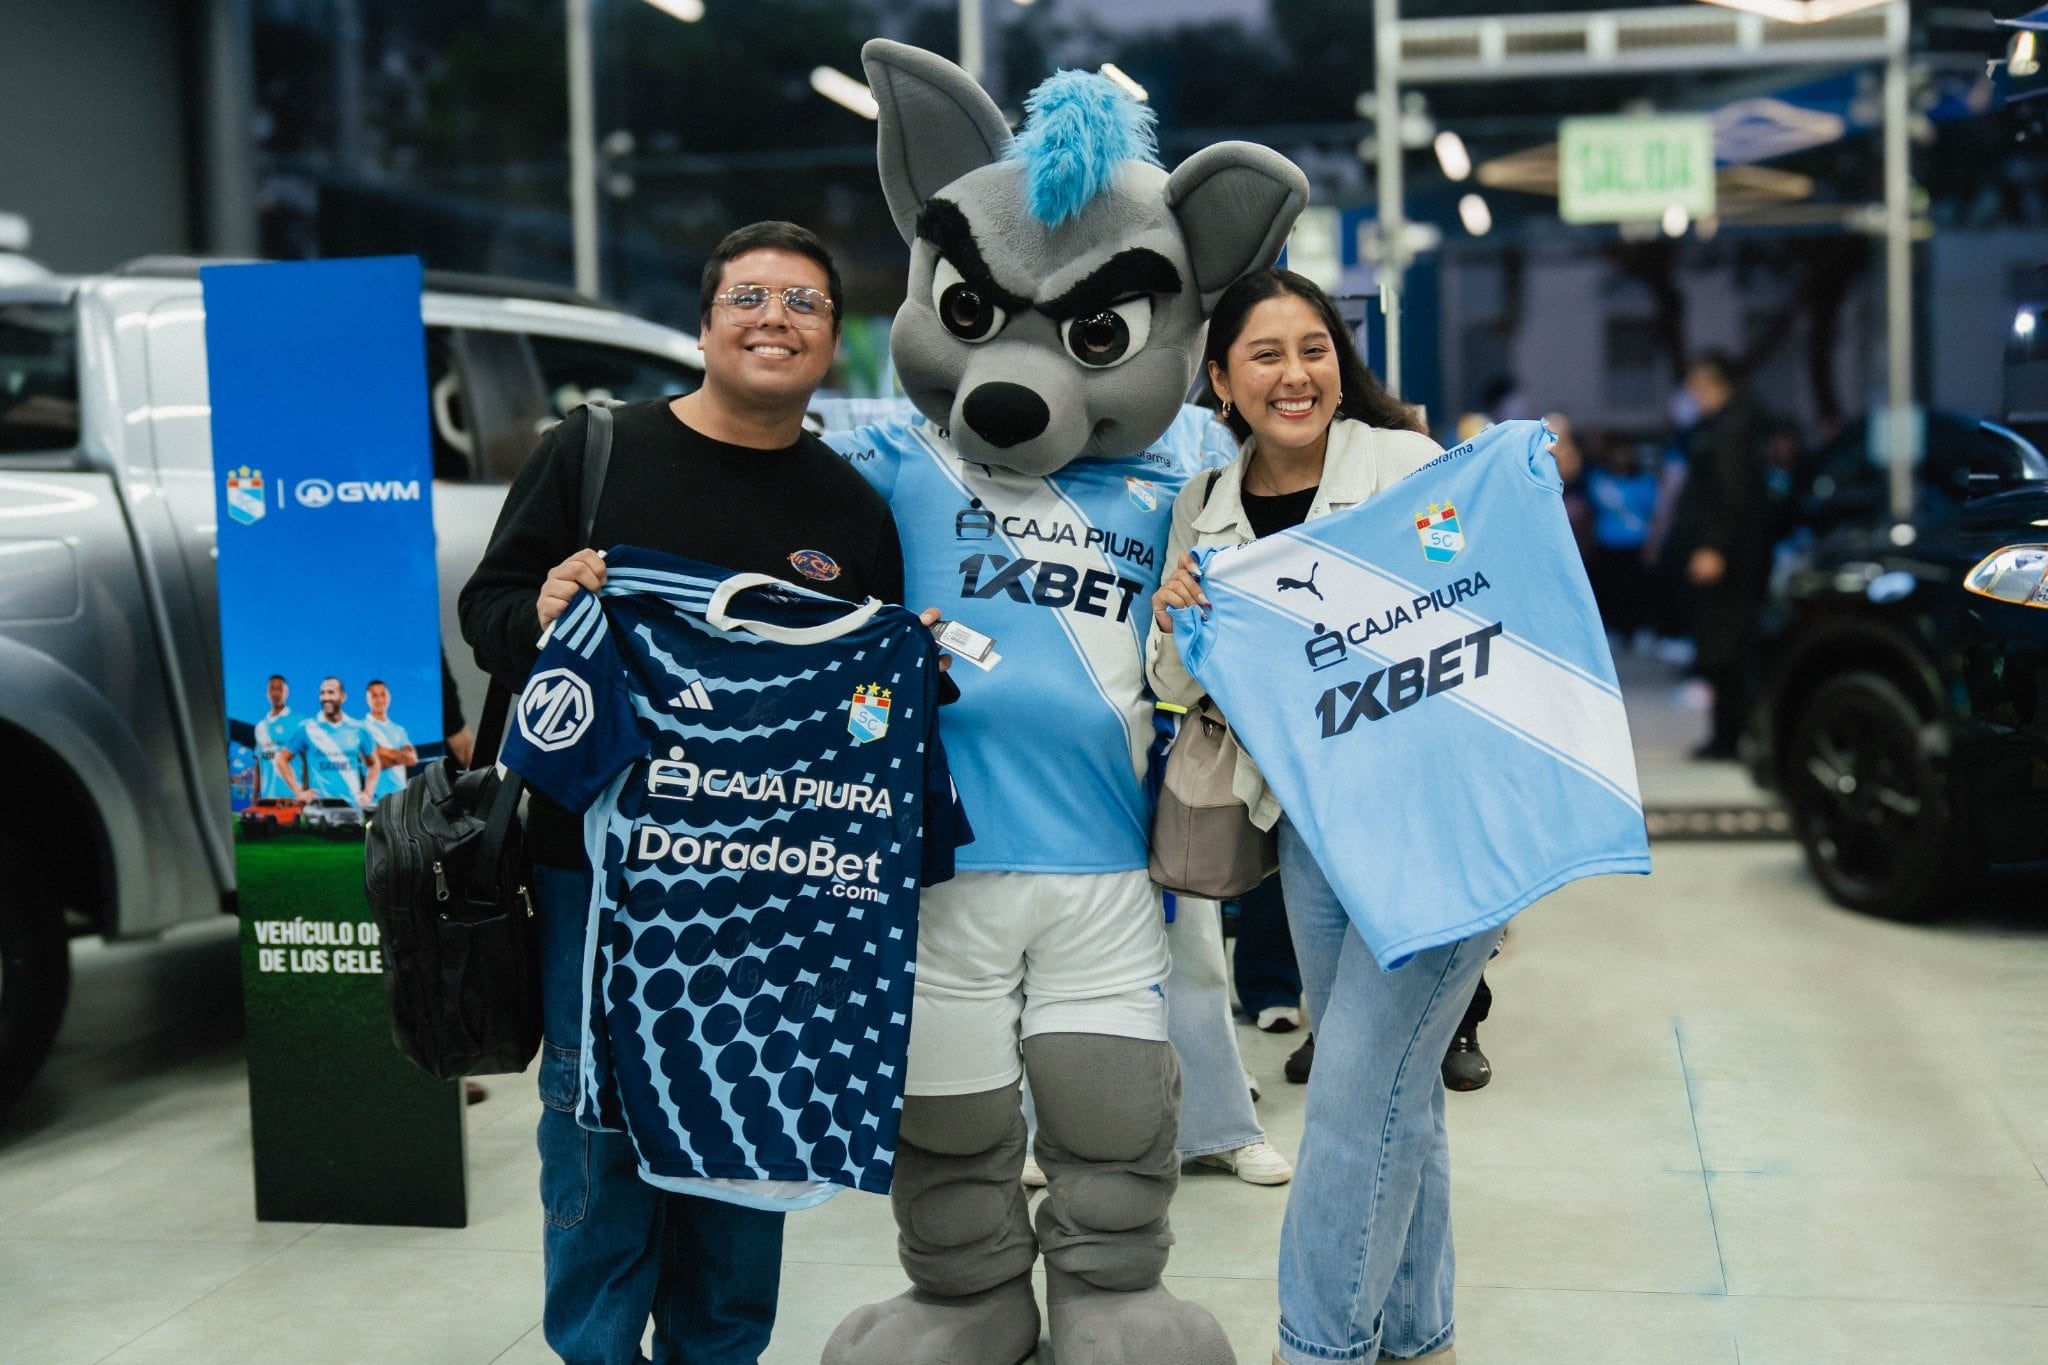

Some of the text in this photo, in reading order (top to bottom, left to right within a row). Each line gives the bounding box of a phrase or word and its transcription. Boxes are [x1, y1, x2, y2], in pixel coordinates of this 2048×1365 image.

[336, 480, 420, 502] GWM
[1002, 516, 1154, 571] CAJA PIURA
[1431, 532, 1453, 547] SC
[958, 553, 1144, 623] 1XBET
[1346, 571, 1491, 645] CAJA PIURA
[1314, 621, 1503, 739] 1XBET
[525, 679, 586, 742] MG
[859, 711, 878, 730] SC
[703, 769, 893, 817] CAJA PIURA
[637, 825, 882, 884] DoradoBet
[825, 884, 879, 901] .com
[254, 916, 354, 946] VEHÍCULO
[259, 948, 287, 973] DE
[290, 949, 330, 973] LOS
